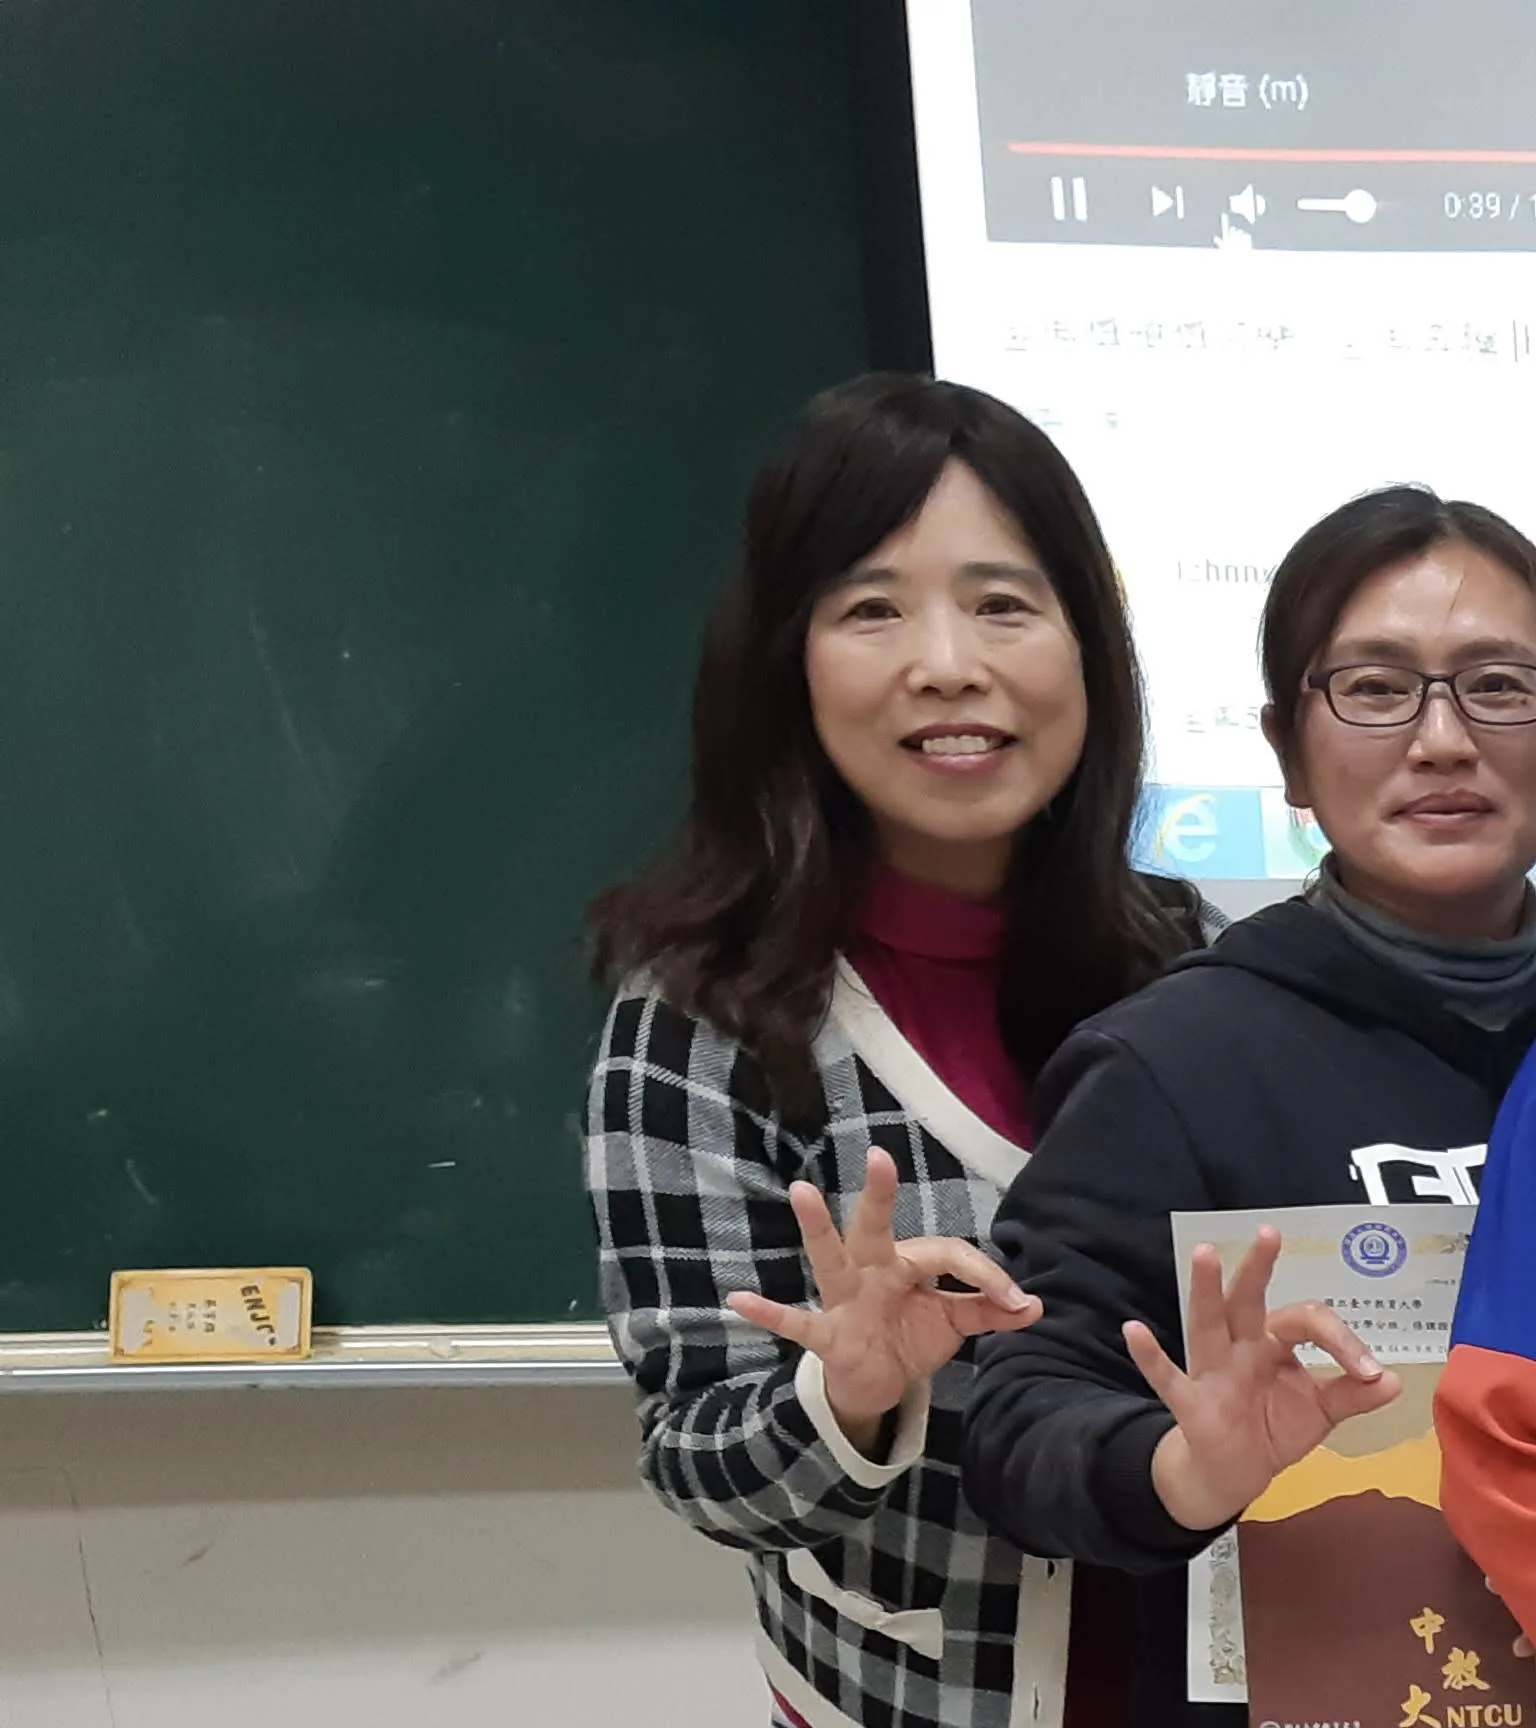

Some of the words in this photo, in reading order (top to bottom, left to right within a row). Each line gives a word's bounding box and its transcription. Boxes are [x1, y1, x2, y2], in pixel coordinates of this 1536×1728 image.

[1259, 73, 1308, 111] (m)
[1443, 191, 1500, 219] 0:39
[1447, 1704, 1522, 1728] NTCU
